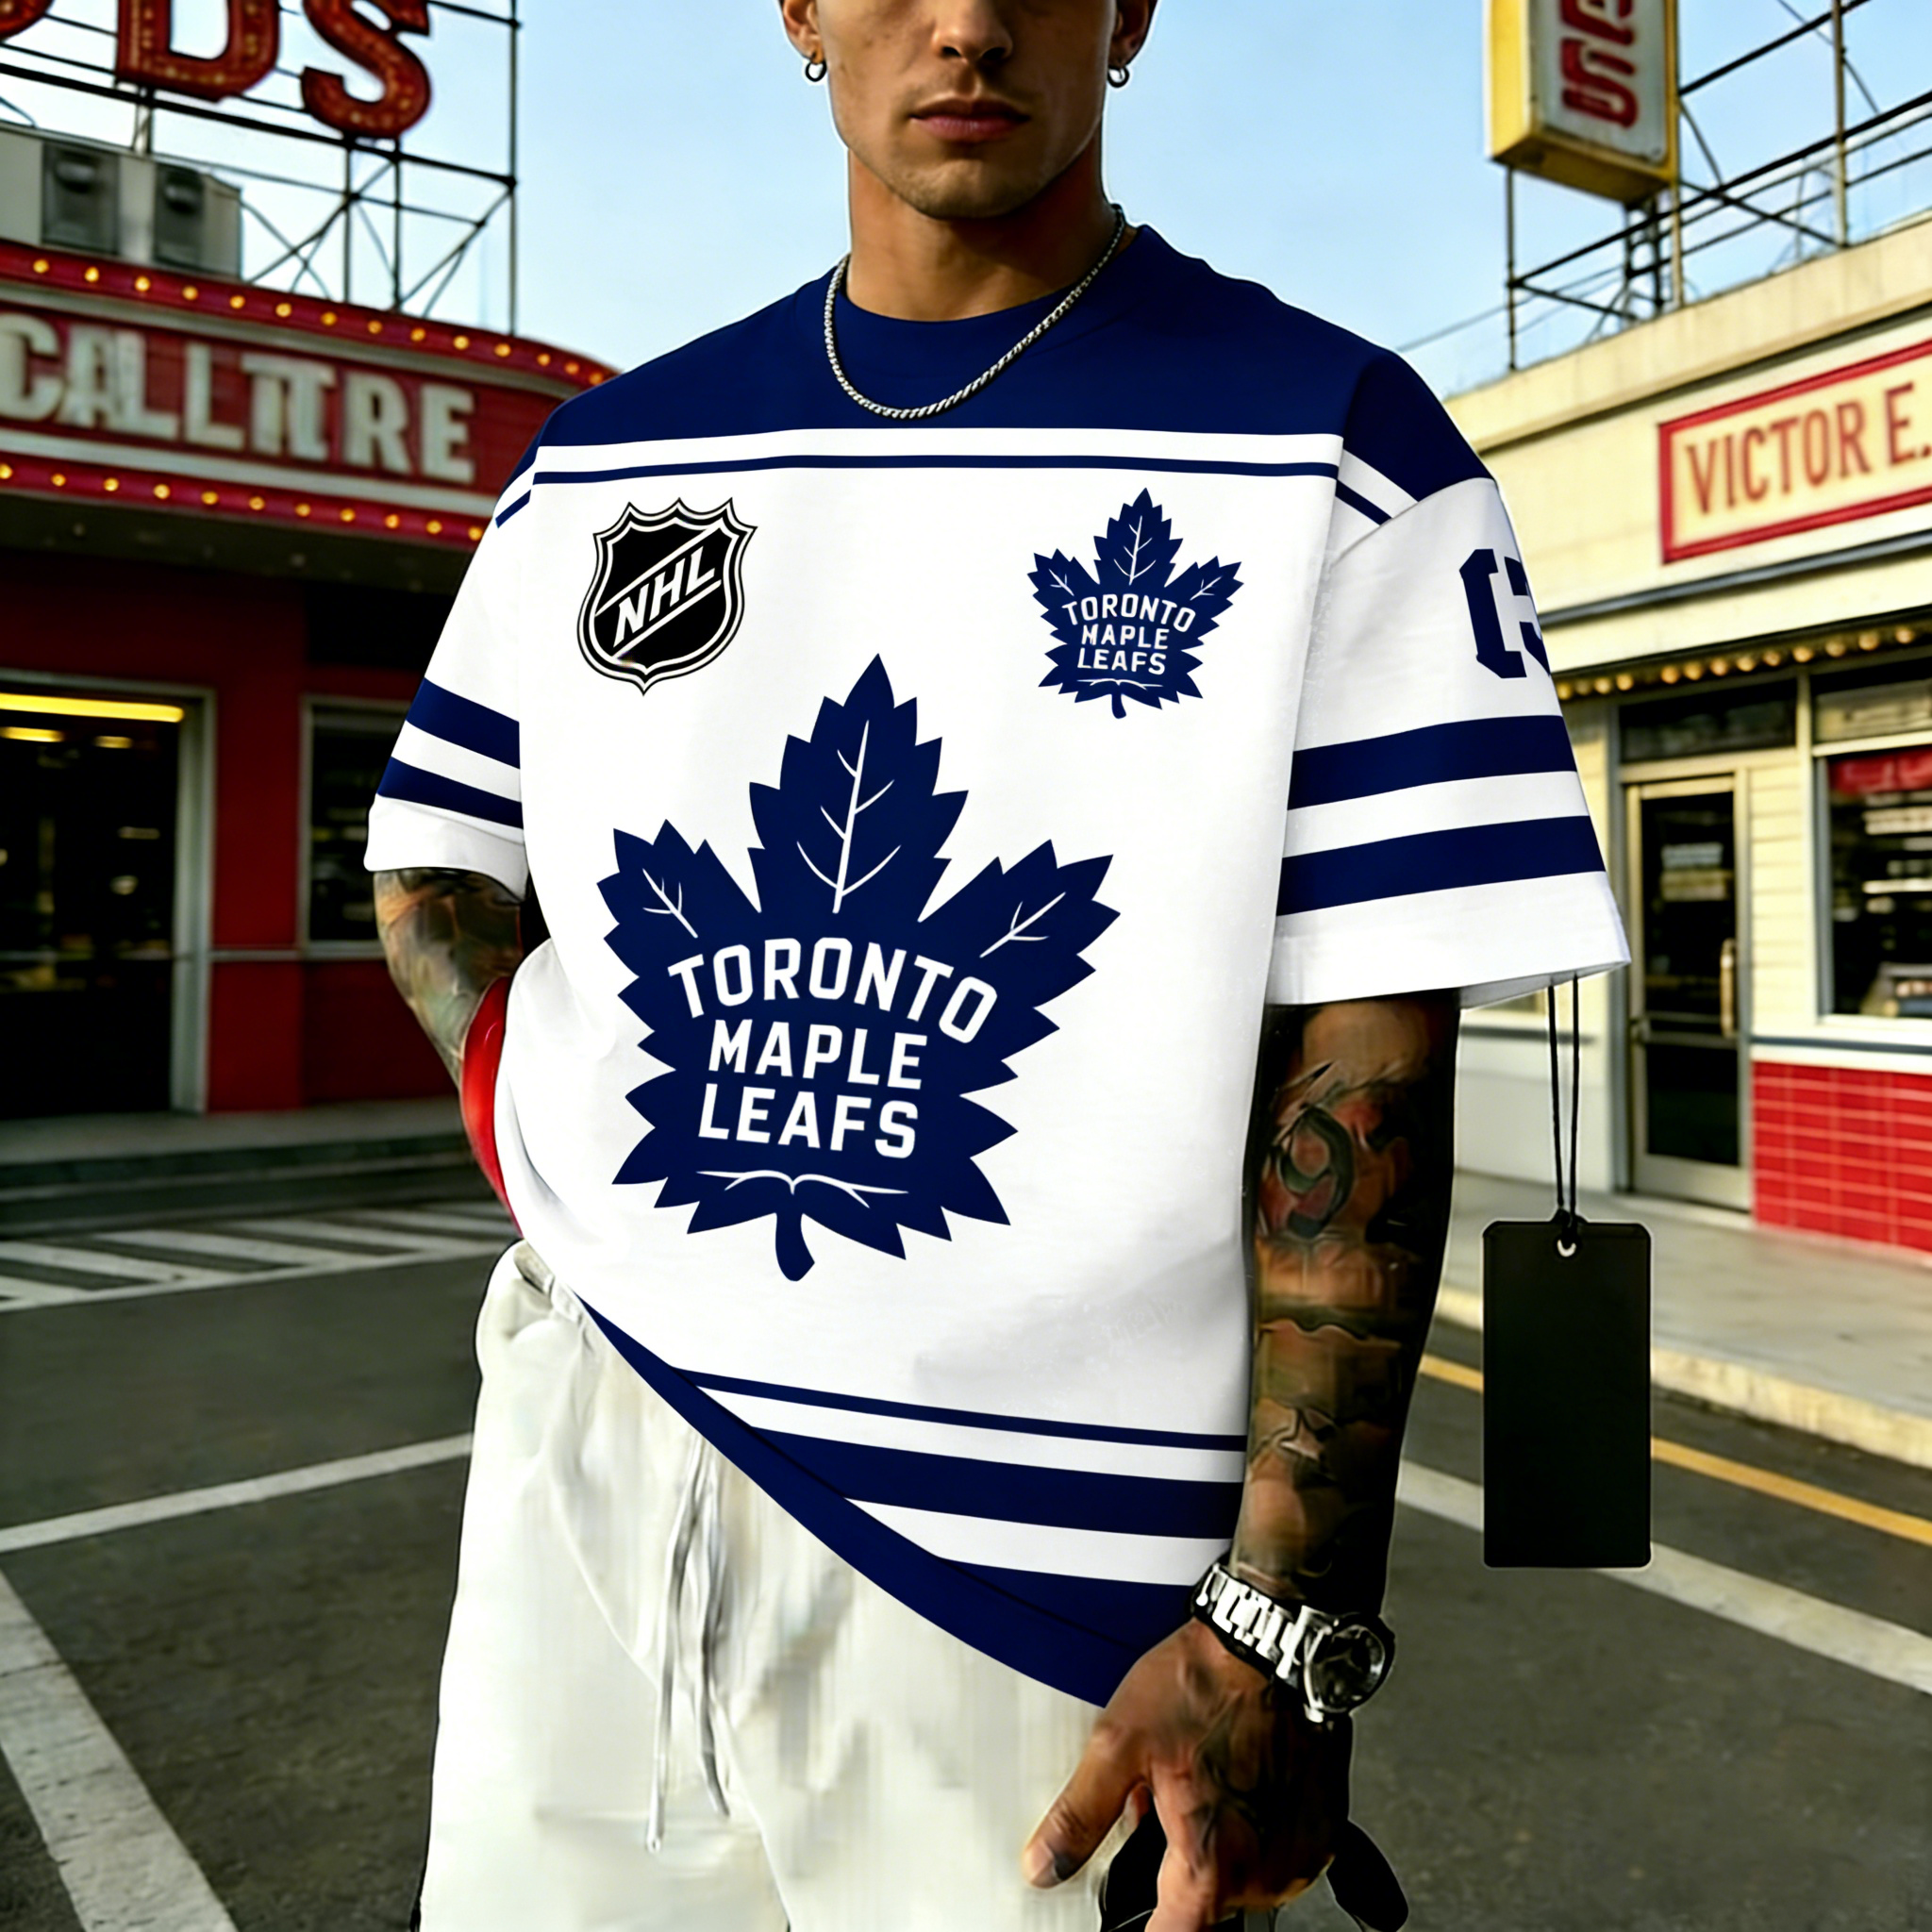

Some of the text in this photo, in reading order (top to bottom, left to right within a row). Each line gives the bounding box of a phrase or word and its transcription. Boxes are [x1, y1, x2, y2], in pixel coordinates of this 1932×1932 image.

[1686, 400, 1872, 515] VICTOR
[613, 545, 716, 648] NHL
[1061, 593, 1196, 633] TORONTO
[1077, 647, 1167, 675] LEAFS
[1081, 624, 1170, 650] MAPLE
[667, 937, 998, 1043] TORONTO
[708, 1018, 928, 1090] MAPLE
[698, 1083, 918, 1158] LEAFS
